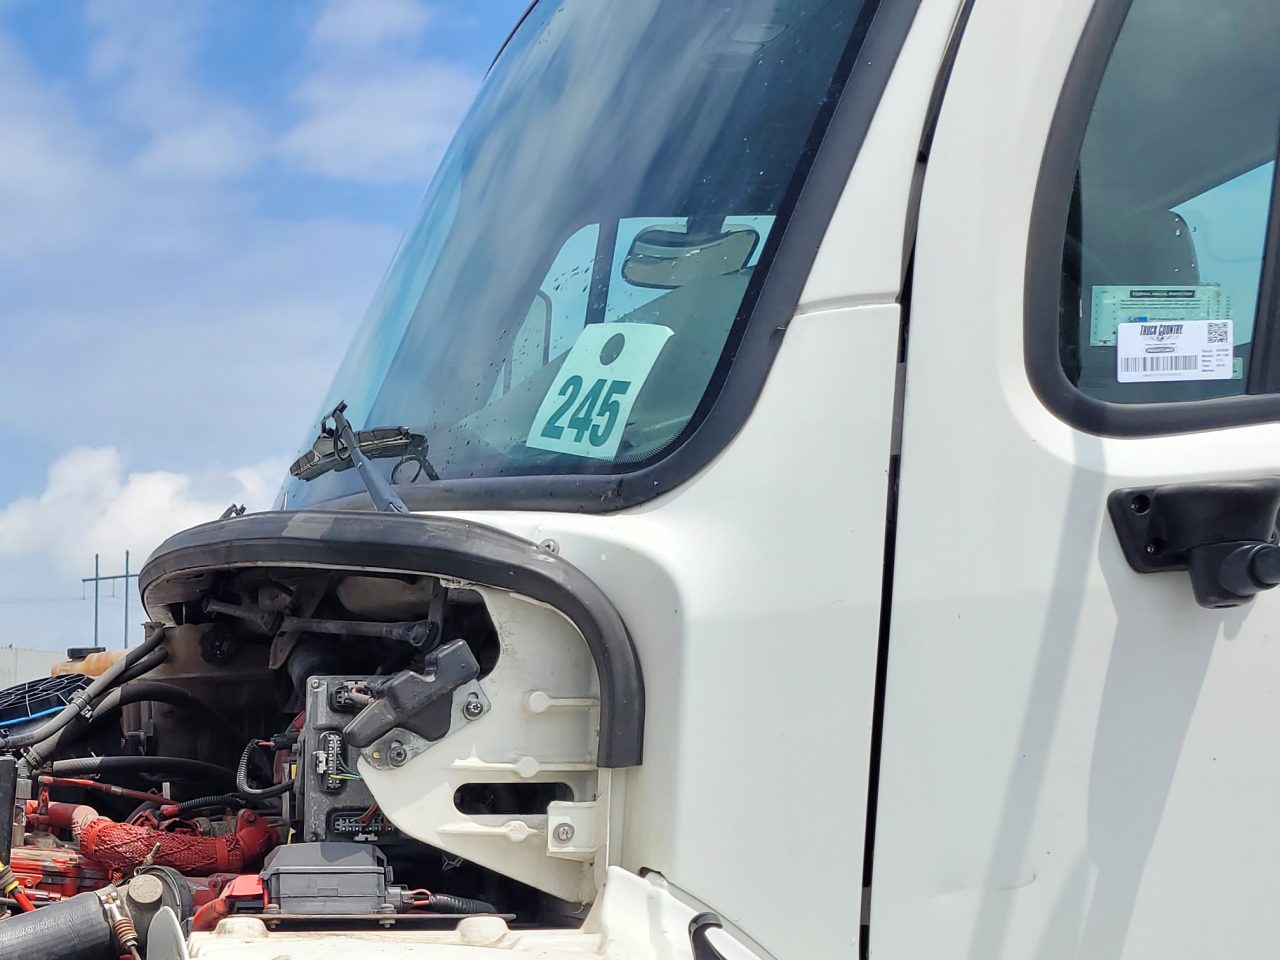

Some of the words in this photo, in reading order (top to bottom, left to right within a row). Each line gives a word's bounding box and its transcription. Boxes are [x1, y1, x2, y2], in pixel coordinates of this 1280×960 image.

[1140, 325, 1159, 336] TRUCK
[1158, 324, 1184, 336] COUNTRY
[540, 375, 632, 447] 245
